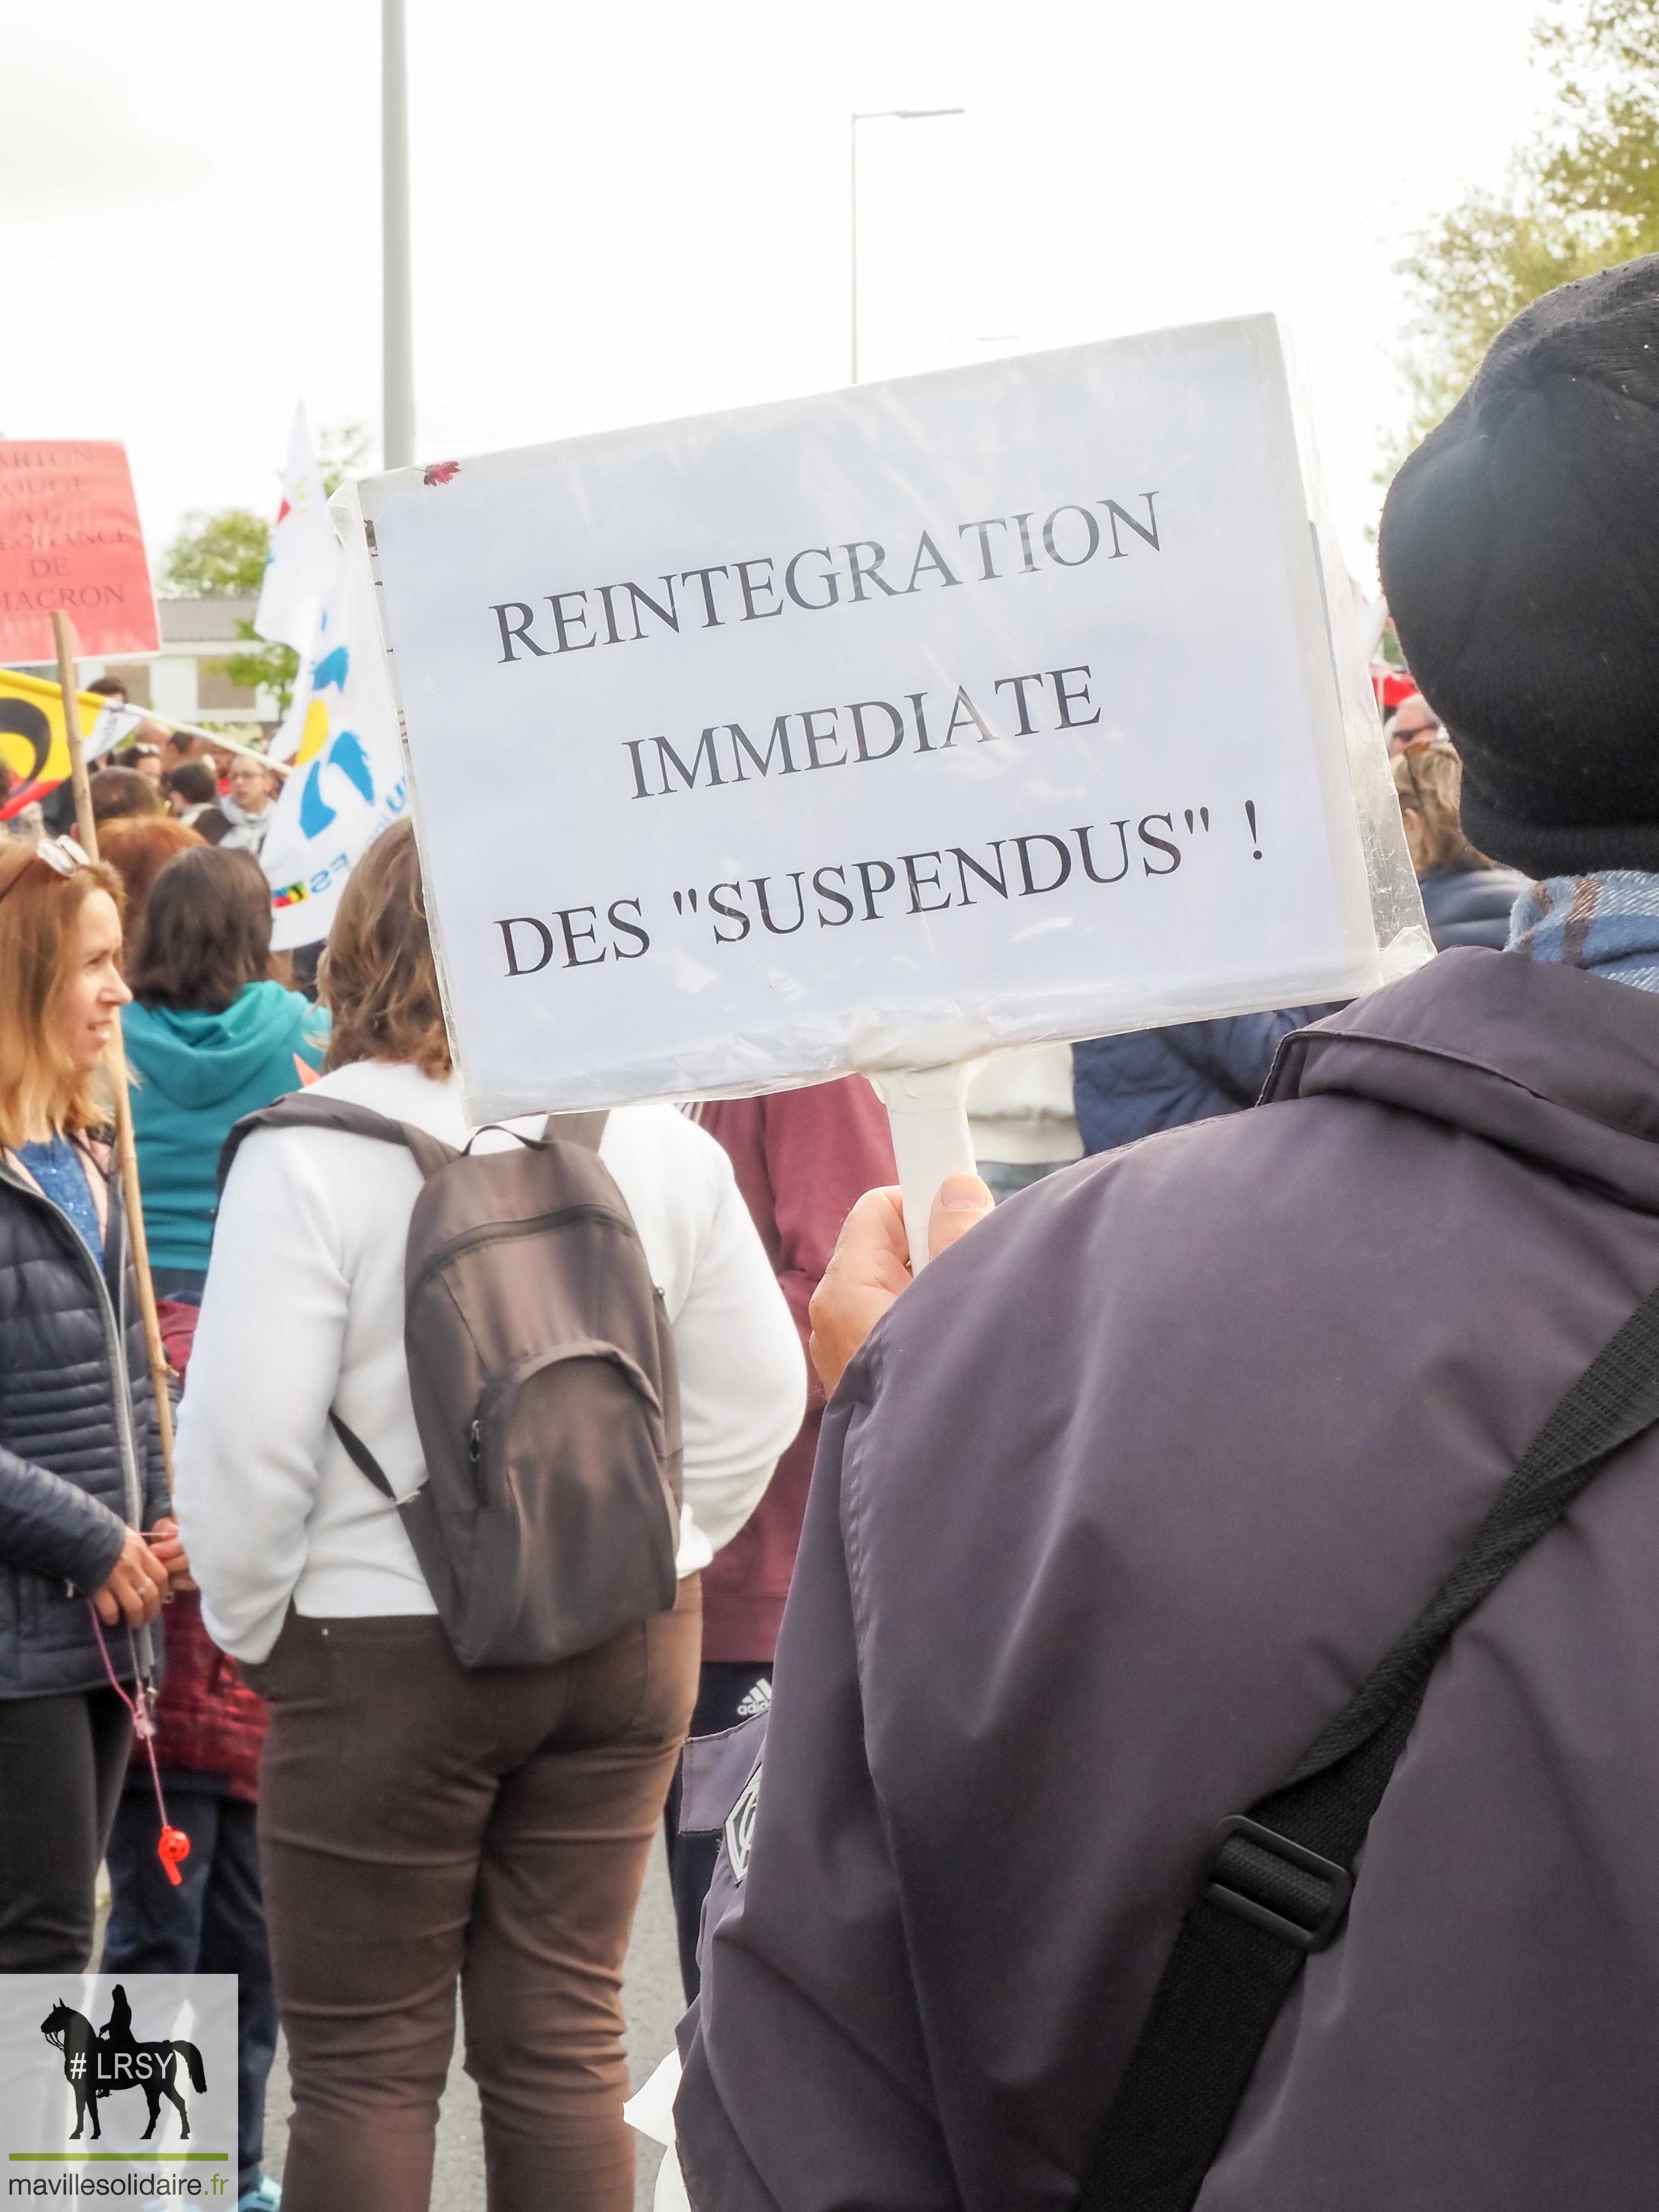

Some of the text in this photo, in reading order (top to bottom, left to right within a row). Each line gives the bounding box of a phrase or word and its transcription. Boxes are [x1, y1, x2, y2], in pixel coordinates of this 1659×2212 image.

[0, 476, 87, 496] OUGE
[29, 557, 70, 577] DE
[488, 491, 1161, 664] REINTEGRATION
[622, 665, 1102, 800] IMMEDIATE
[493, 799, 1263, 977] DES "SUSPENDUS" !
